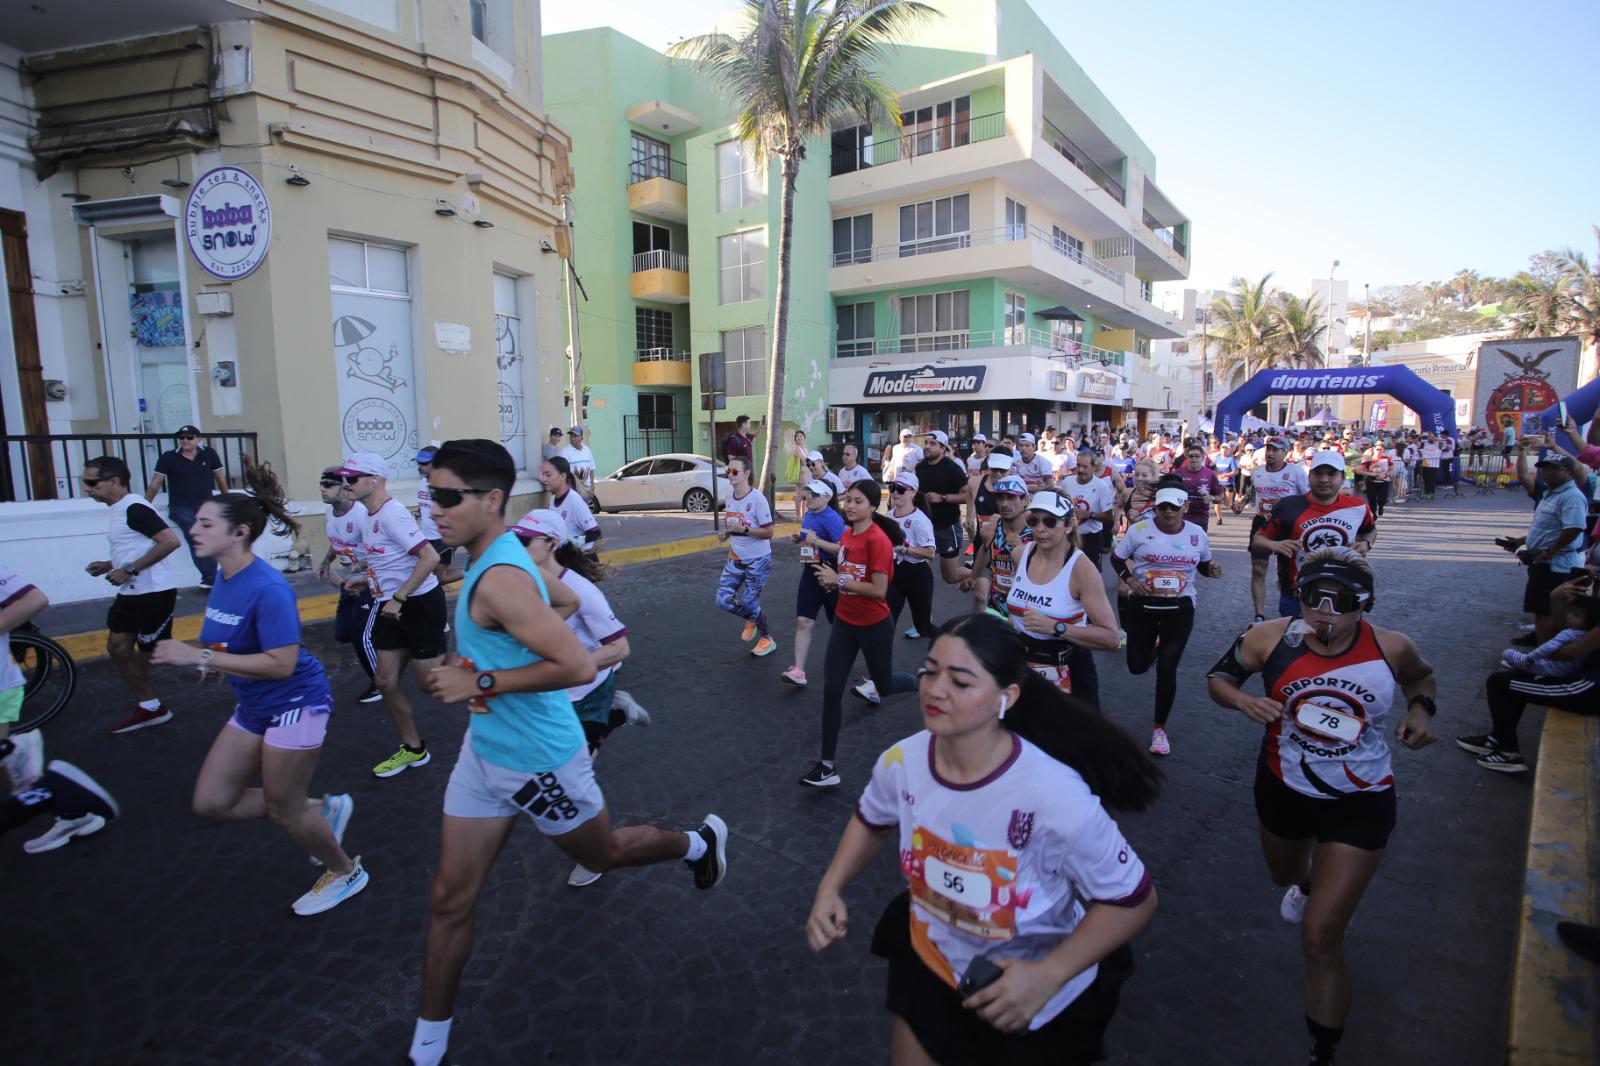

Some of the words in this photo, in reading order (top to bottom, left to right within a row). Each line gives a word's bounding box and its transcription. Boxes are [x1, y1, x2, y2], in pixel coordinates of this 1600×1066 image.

[189, 187, 206, 237] bubble
[208, 173, 226, 185] tea
[233, 173, 240, 181] &
[244, 181, 267, 224] snacks
[201, 202, 253, 229] boba
[203, 225, 257, 250] snow
[868, 374, 978, 394] Modeama
[1270, 374, 1378, 390] dportenis
[356, 418, 394, 431] boba
[357, 430, 397, 441] snow
[1300, 517, 1353, 531] DEPORTIVO
[1012, 588, 1053, 607] TRIMAZ
[1282, 677, 1376, 703] DEPORTIVO
[1319, 713, 1340, 729] 78
[346, 867, 362, 886] HOKA
[943, 872, 965, 894] 56
